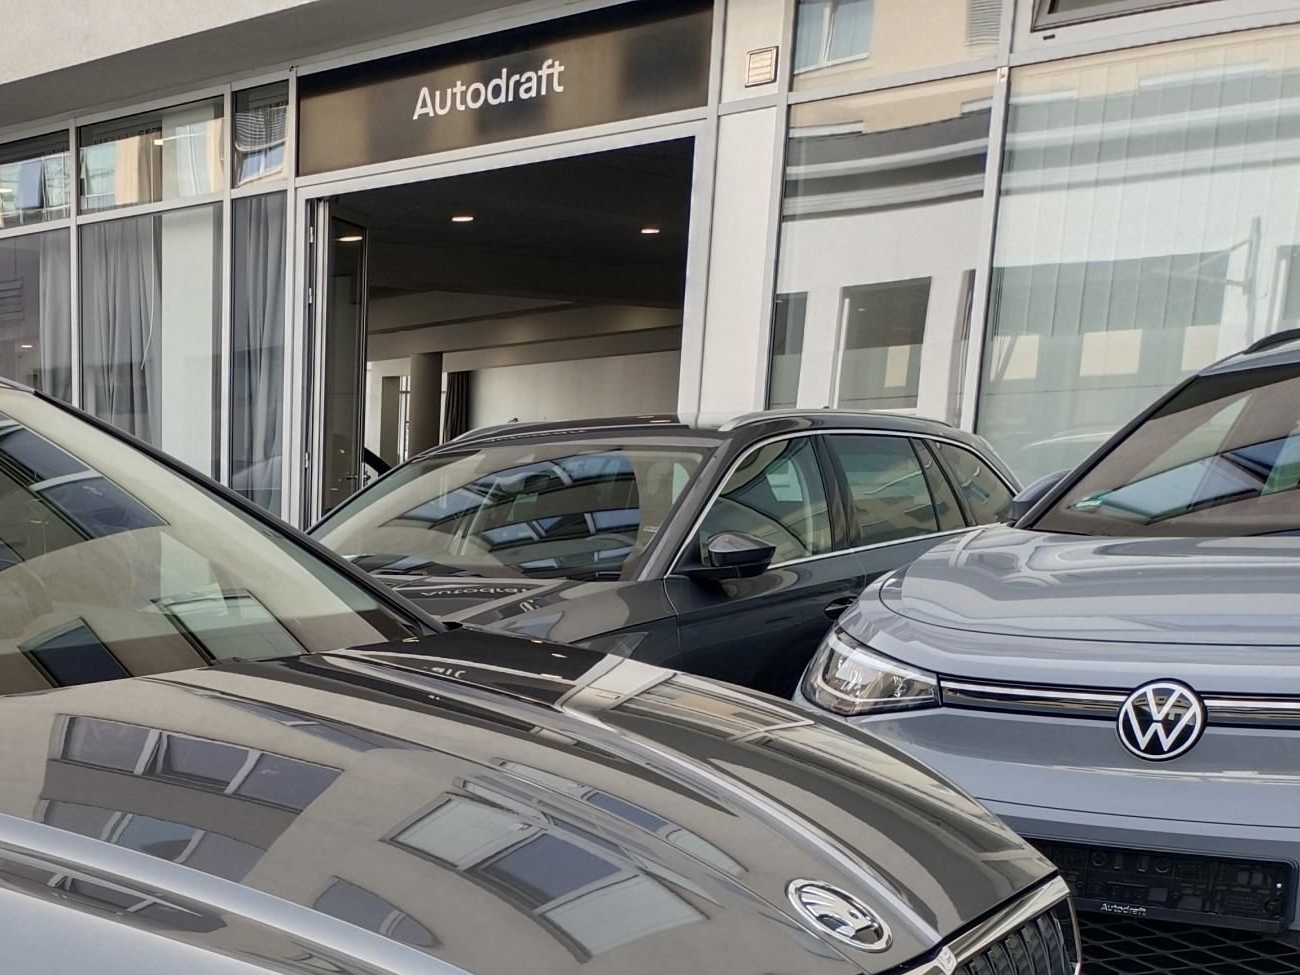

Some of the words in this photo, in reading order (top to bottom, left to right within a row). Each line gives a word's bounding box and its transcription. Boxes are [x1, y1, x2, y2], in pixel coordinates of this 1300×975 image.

[412, 58, 565, 120] Autodraft
[1123, 684, 1198, 756] VW
[1101, 903, 1147, 916] Autodraft
